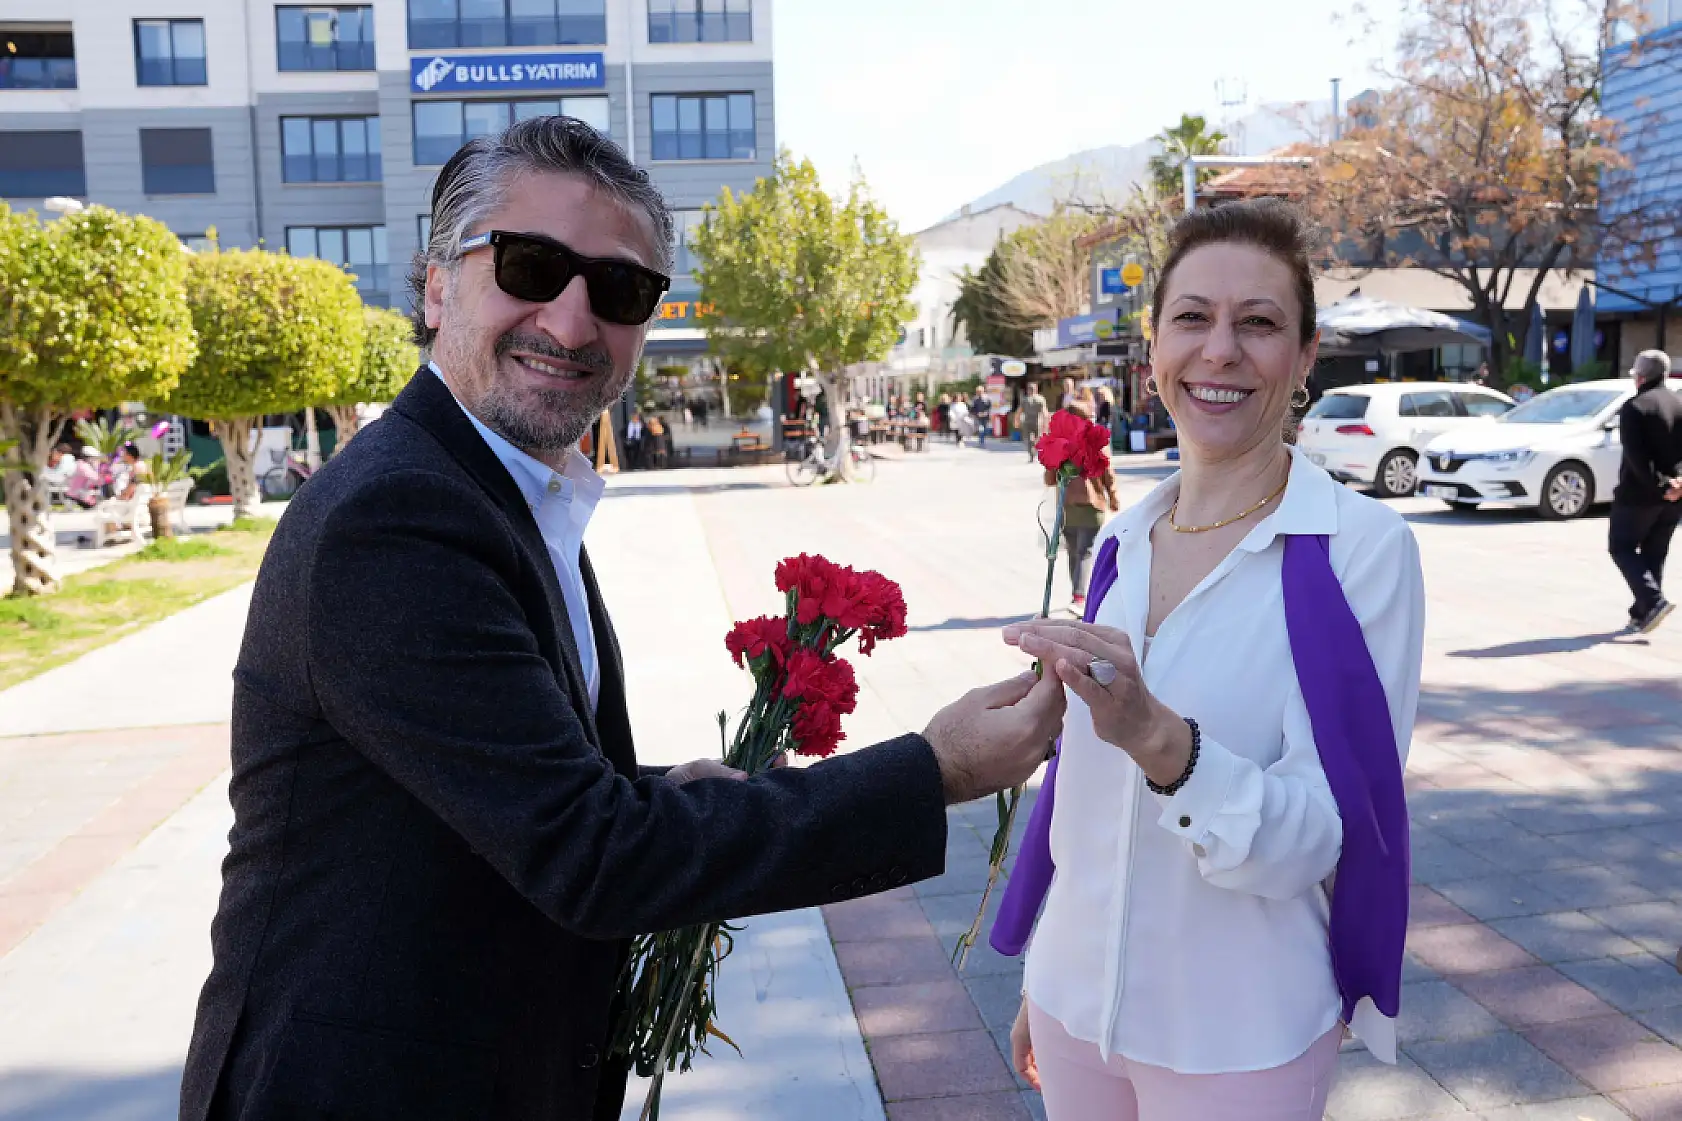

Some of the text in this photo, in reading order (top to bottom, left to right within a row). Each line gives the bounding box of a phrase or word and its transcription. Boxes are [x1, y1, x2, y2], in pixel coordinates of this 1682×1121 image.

[455, 62, 598, 82] BULLS YATIRIM
[659, 301, 688, 319] ET
